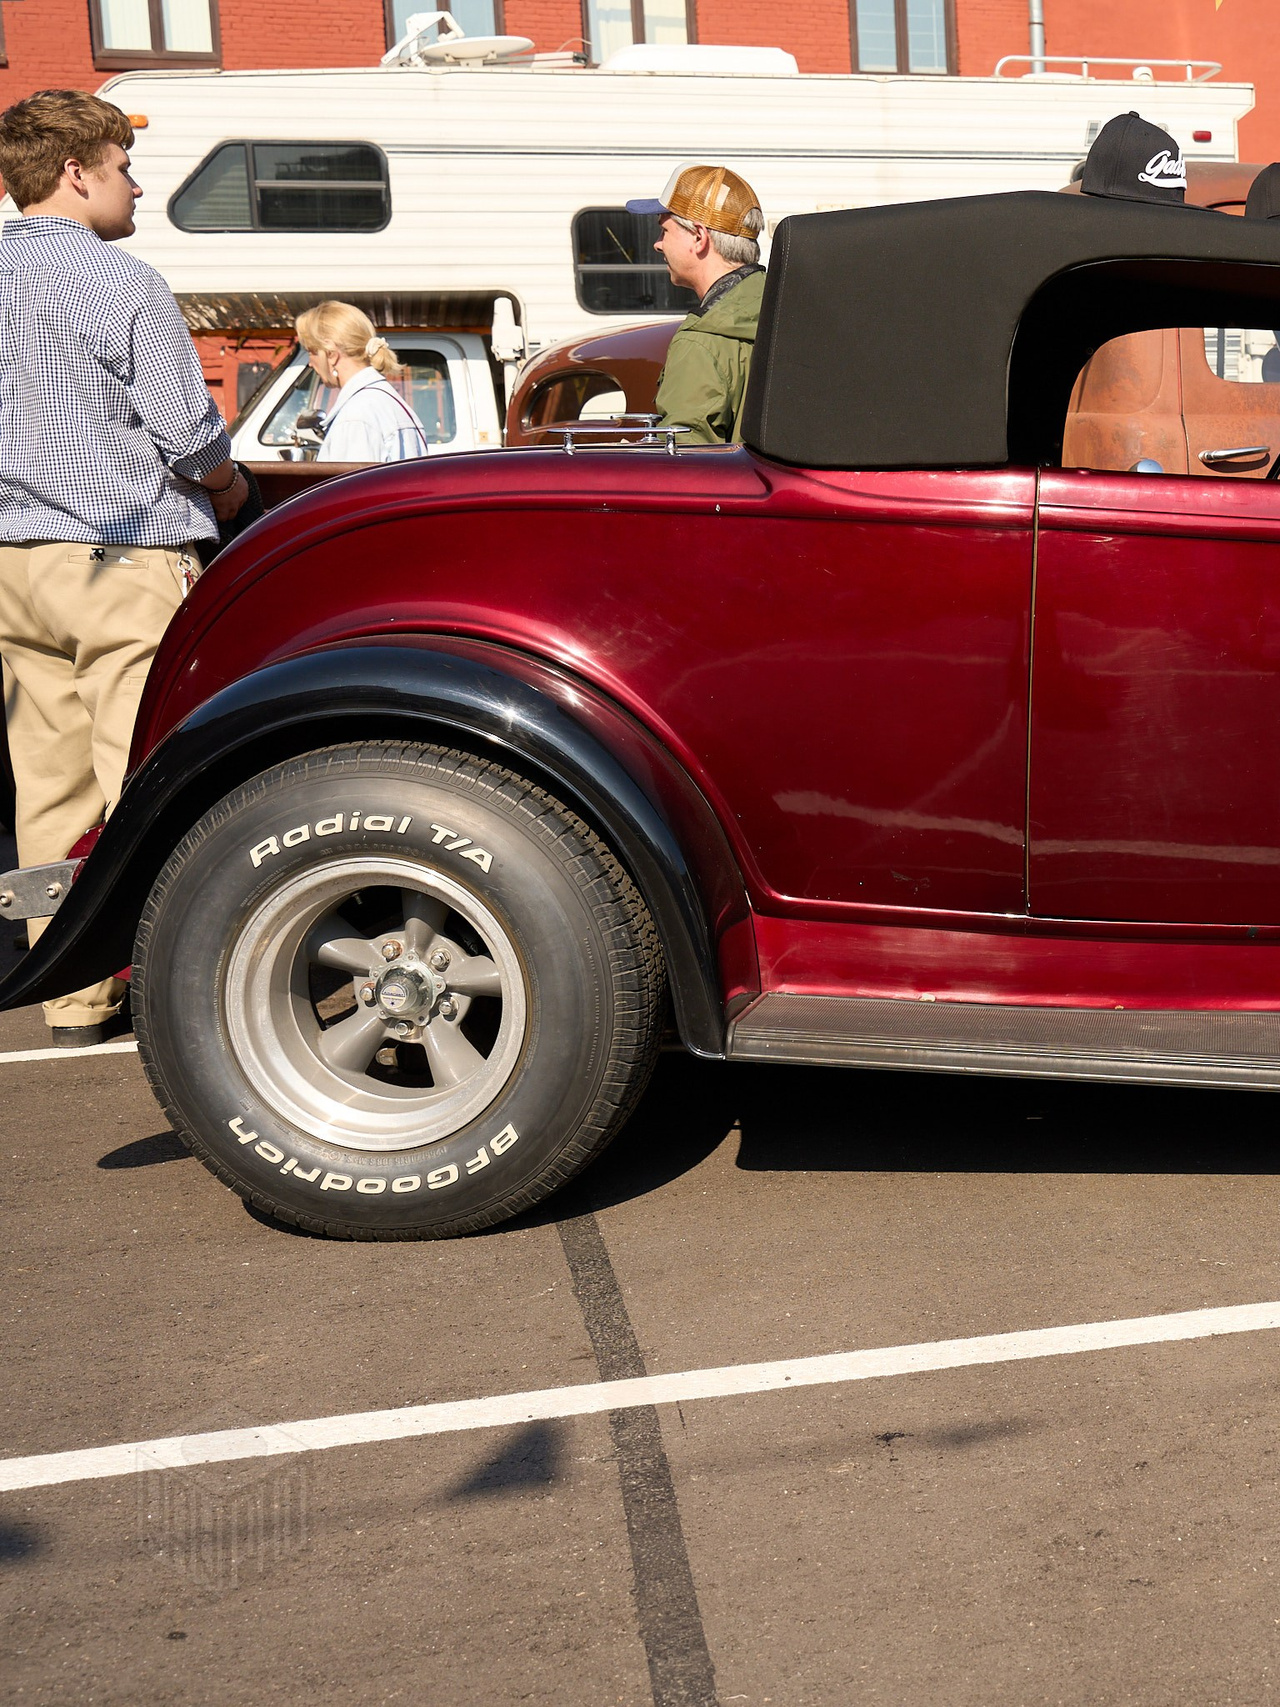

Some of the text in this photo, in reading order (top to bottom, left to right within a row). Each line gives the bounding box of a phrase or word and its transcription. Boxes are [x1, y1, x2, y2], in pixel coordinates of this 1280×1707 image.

[249, 811, 412, 868] Radial
[430, 823, 495, 875] T/A
[227, 1115, 520, 1195] BFGoodrich
